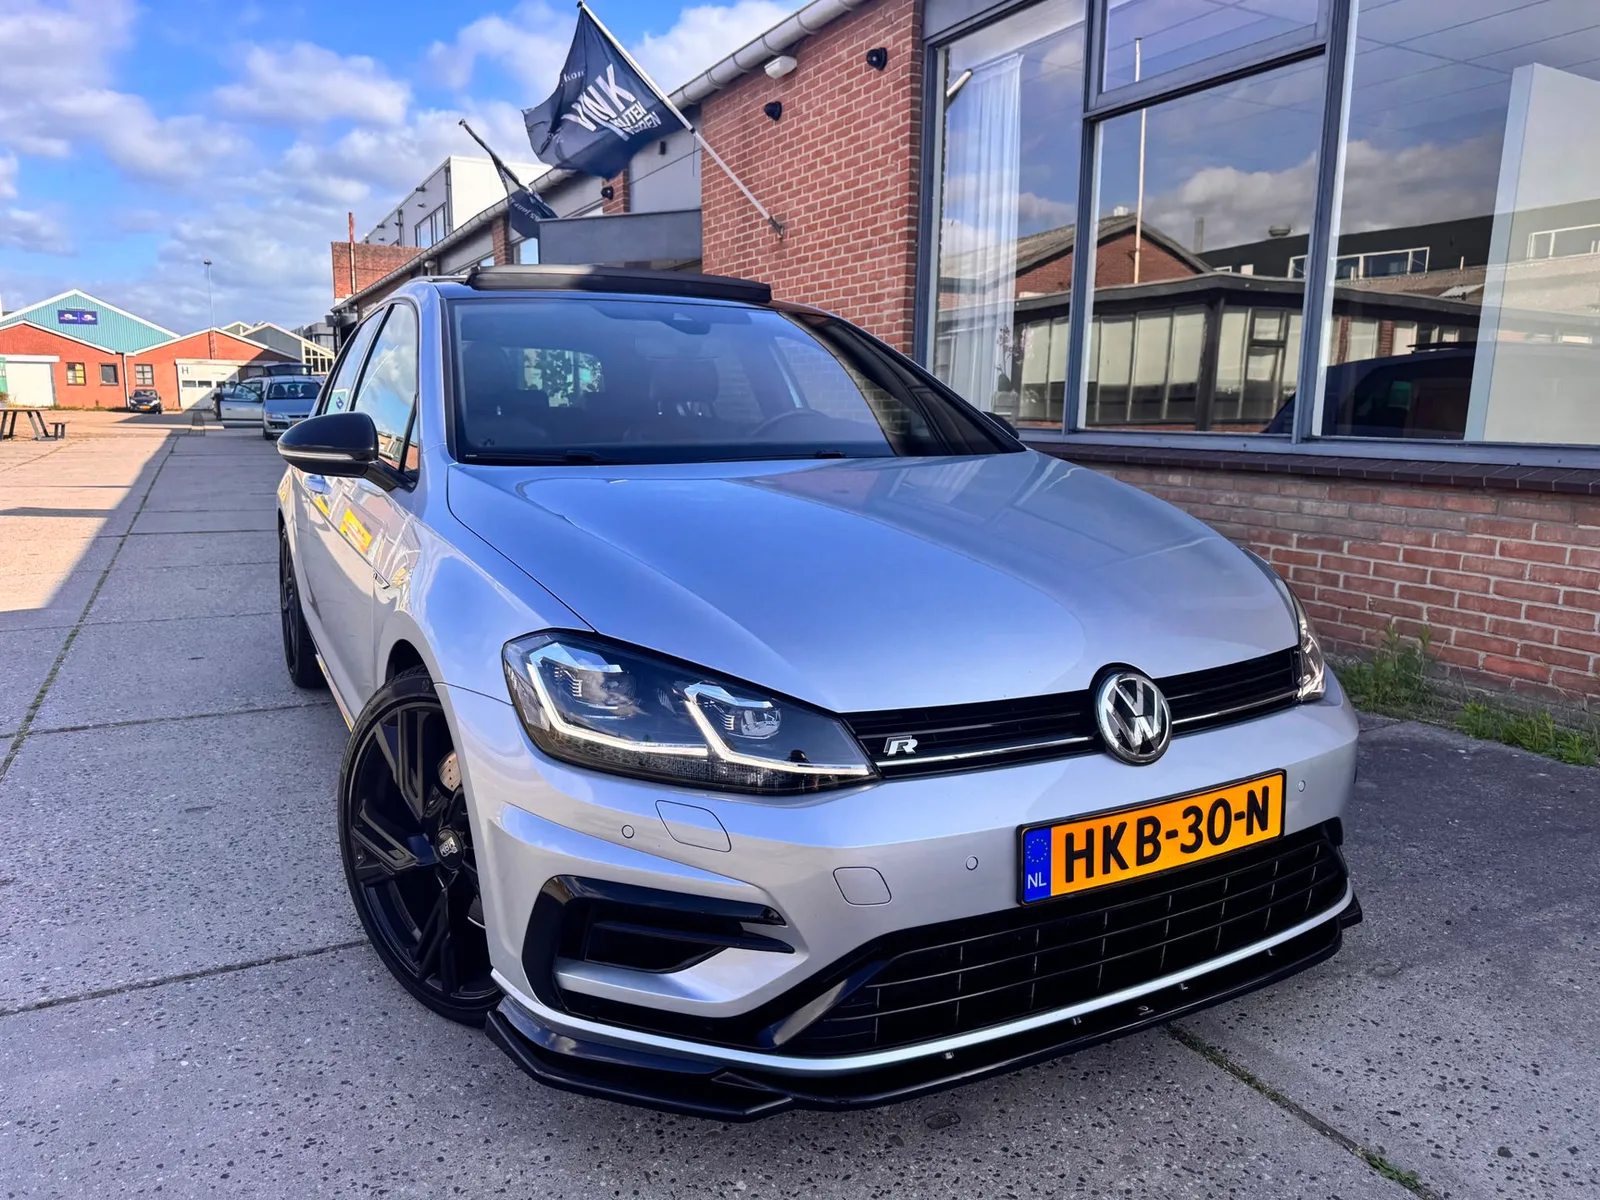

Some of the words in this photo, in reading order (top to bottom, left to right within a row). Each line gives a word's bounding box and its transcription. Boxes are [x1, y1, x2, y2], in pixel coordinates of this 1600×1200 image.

[884, 735, 918, 756] R
[1065, 785, 1270, 884] HKB-30-N
[1027, 873, 1047, 889] NL
